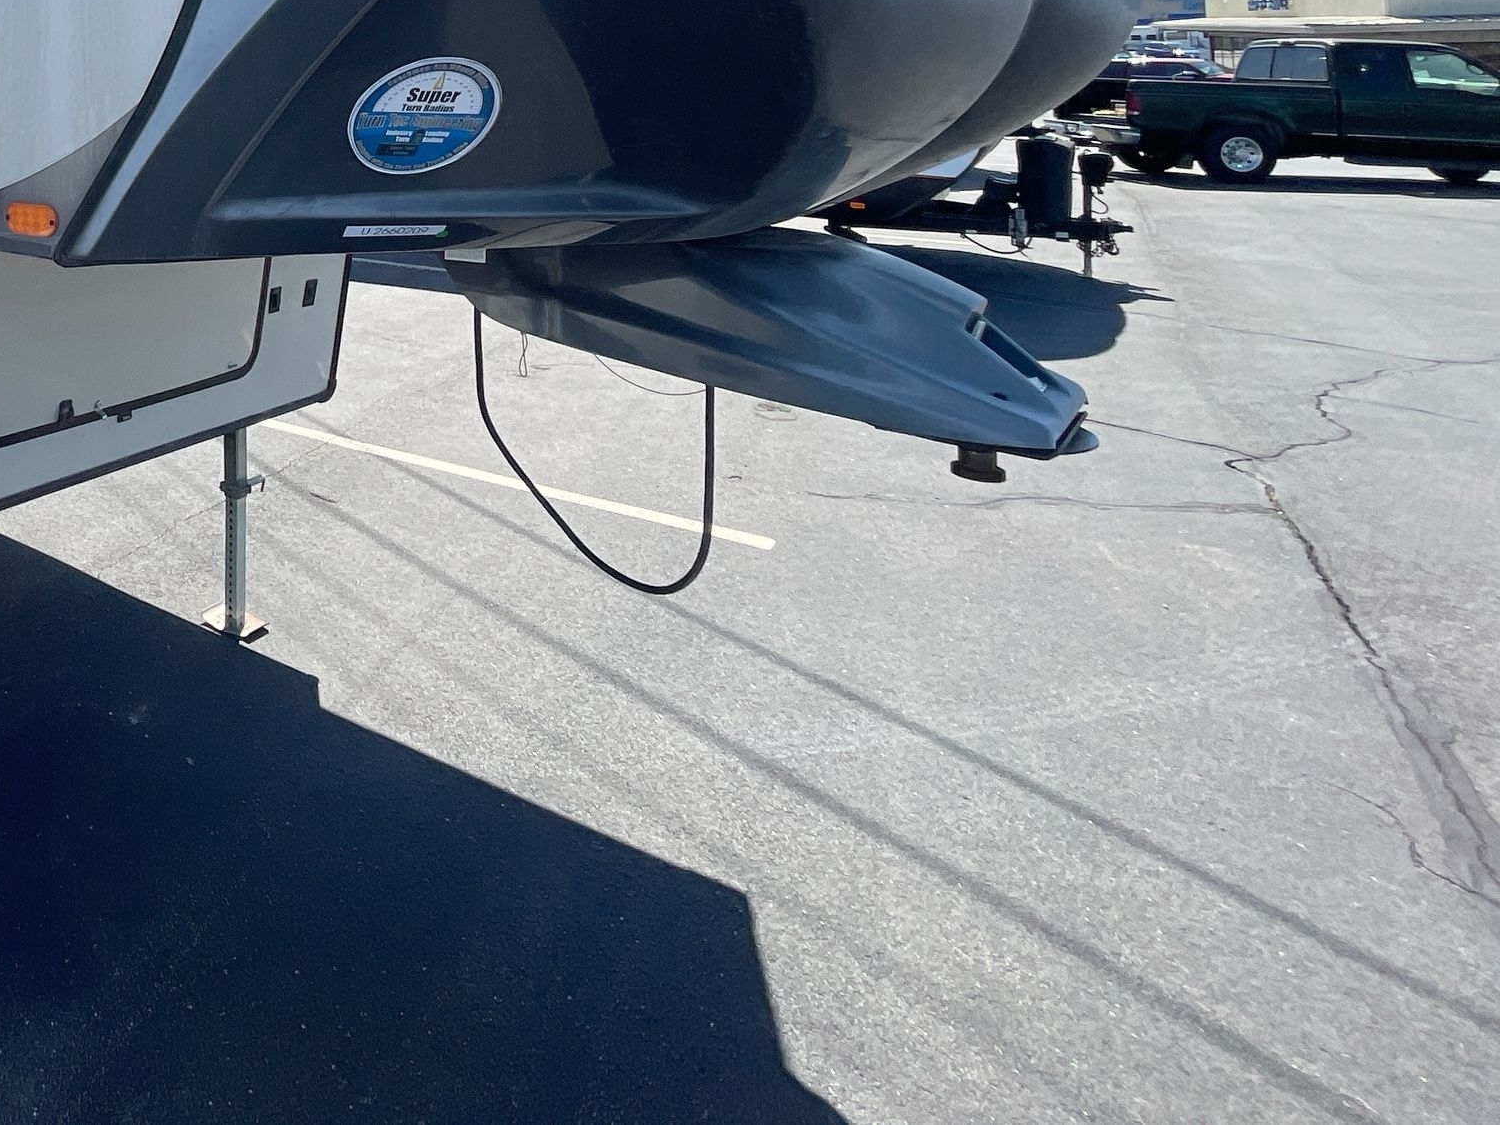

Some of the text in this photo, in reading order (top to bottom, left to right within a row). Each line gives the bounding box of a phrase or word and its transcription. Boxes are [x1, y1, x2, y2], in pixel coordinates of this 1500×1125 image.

[406, 87, 462, 105] Super
[402, 104, 455, 113] Turn Radius
[361, 227, 371, 235] U
